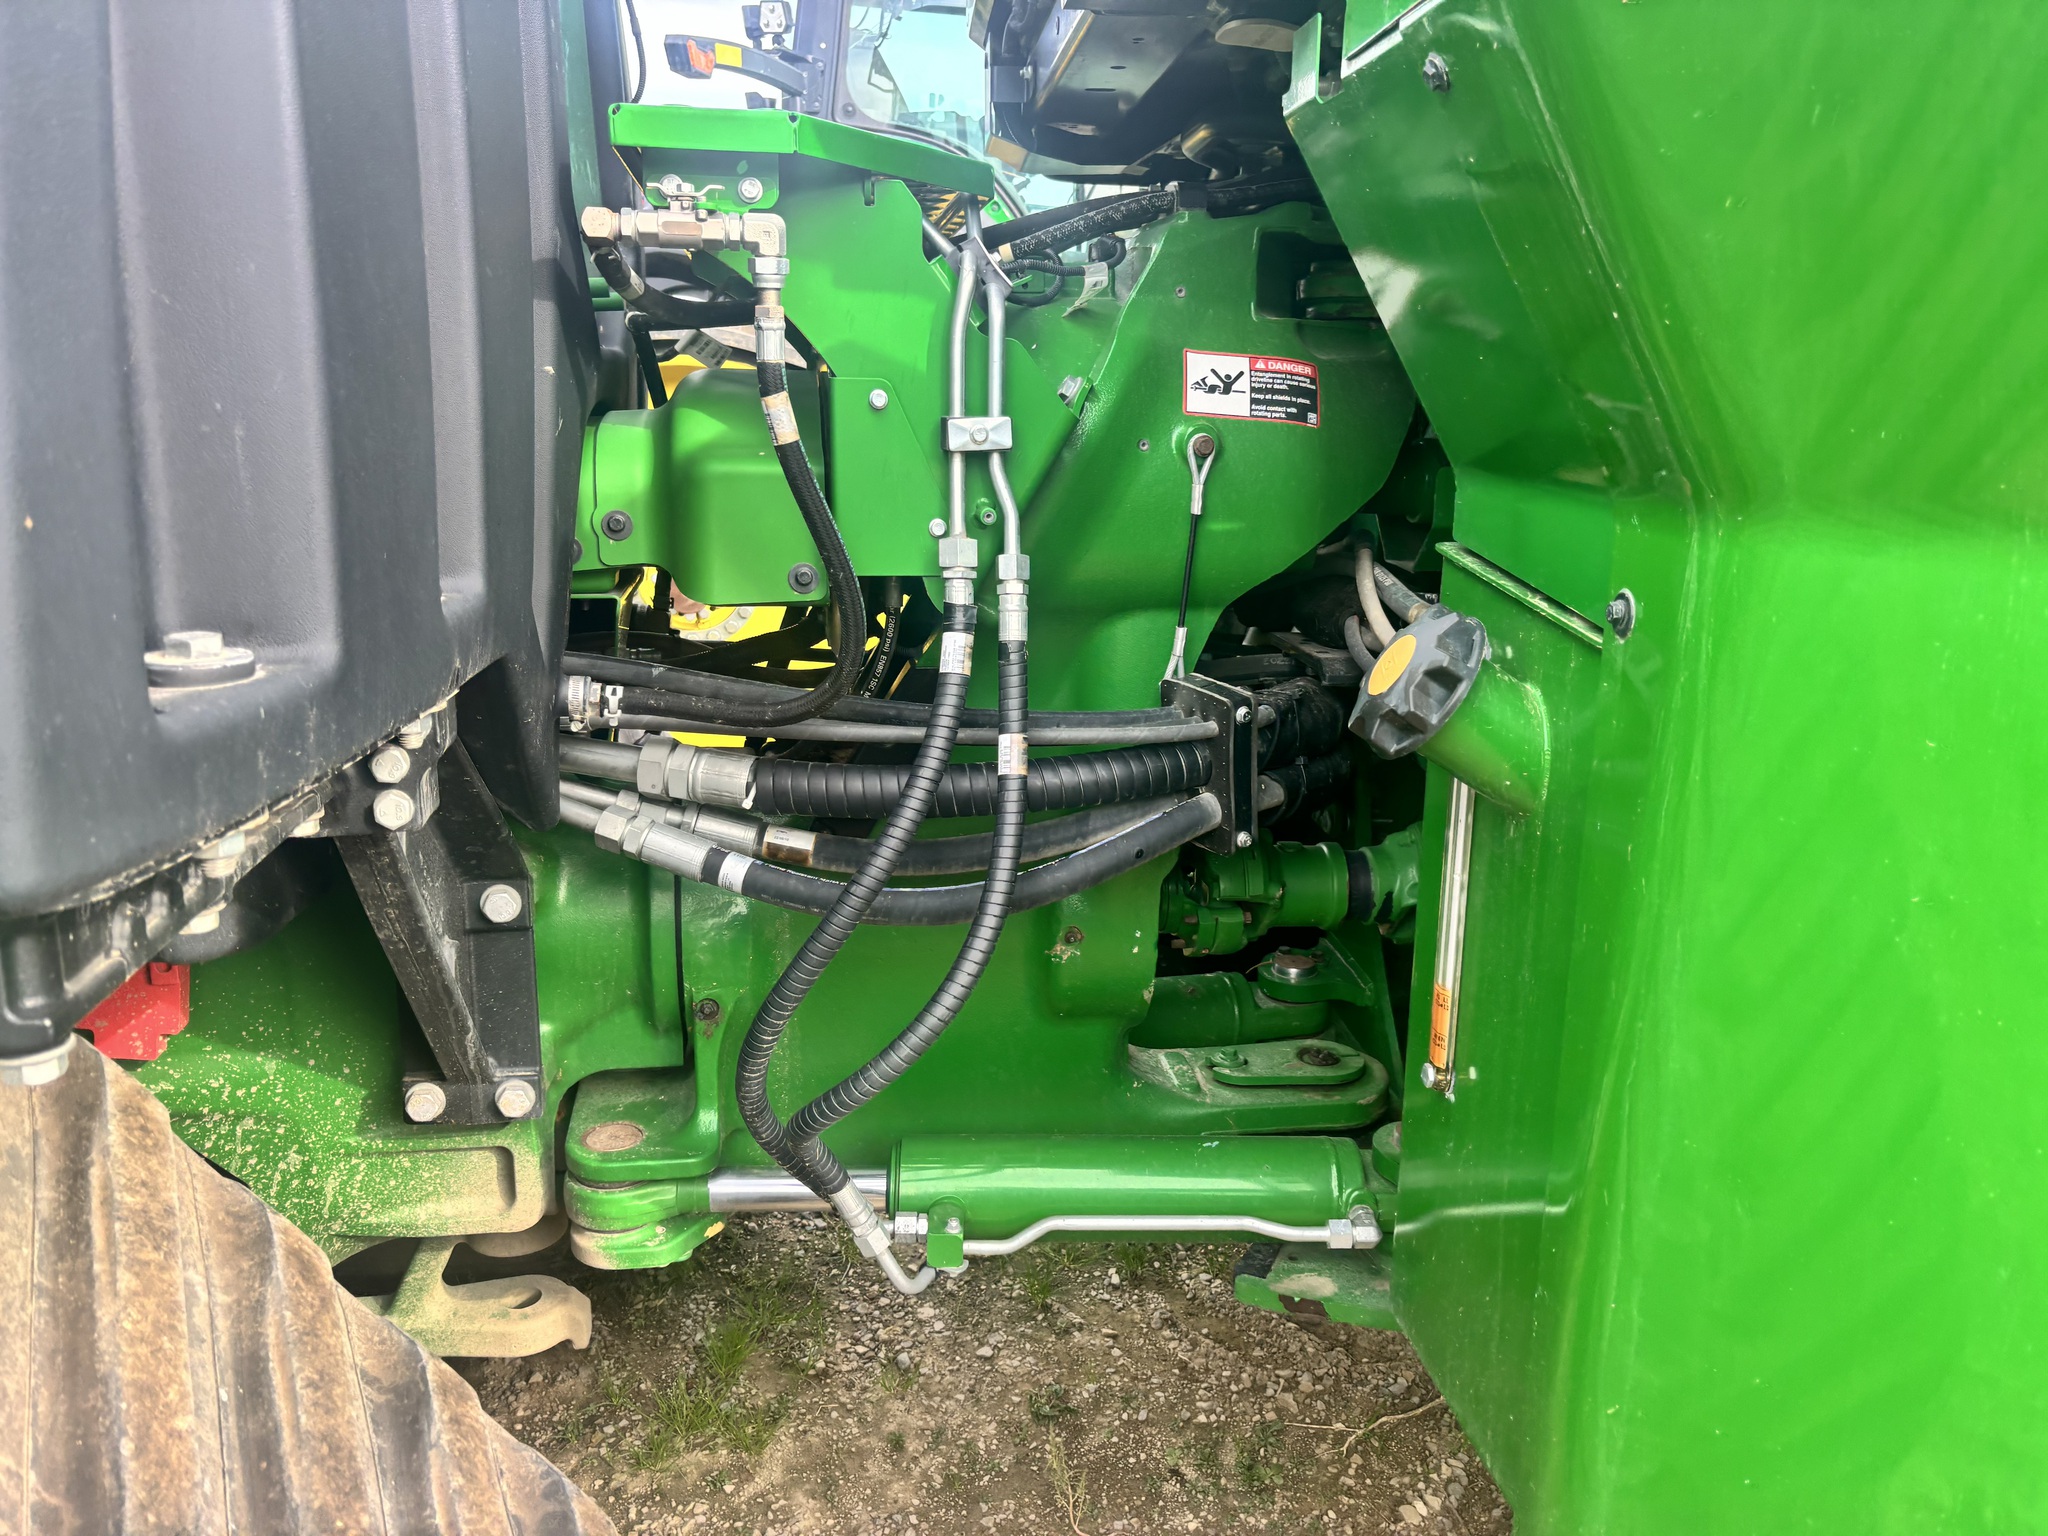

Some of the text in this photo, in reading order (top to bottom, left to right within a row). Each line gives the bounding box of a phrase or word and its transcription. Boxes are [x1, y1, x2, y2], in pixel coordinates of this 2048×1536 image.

[1268, 361, 1311, 375] DANGER
[1251, 370, 1286, 379] Entanglement
[1292, 375, 1310, 384] rotating
[1299, 381, 1316, 389] serious
[1251, 392, 1264, 400] Keep
[887, 616, 896, 637] (2600
[883, 638, 892, 652] psi)
[874, 655, 887, 677] EN857
[868, 678, 879, 691] 1SC
